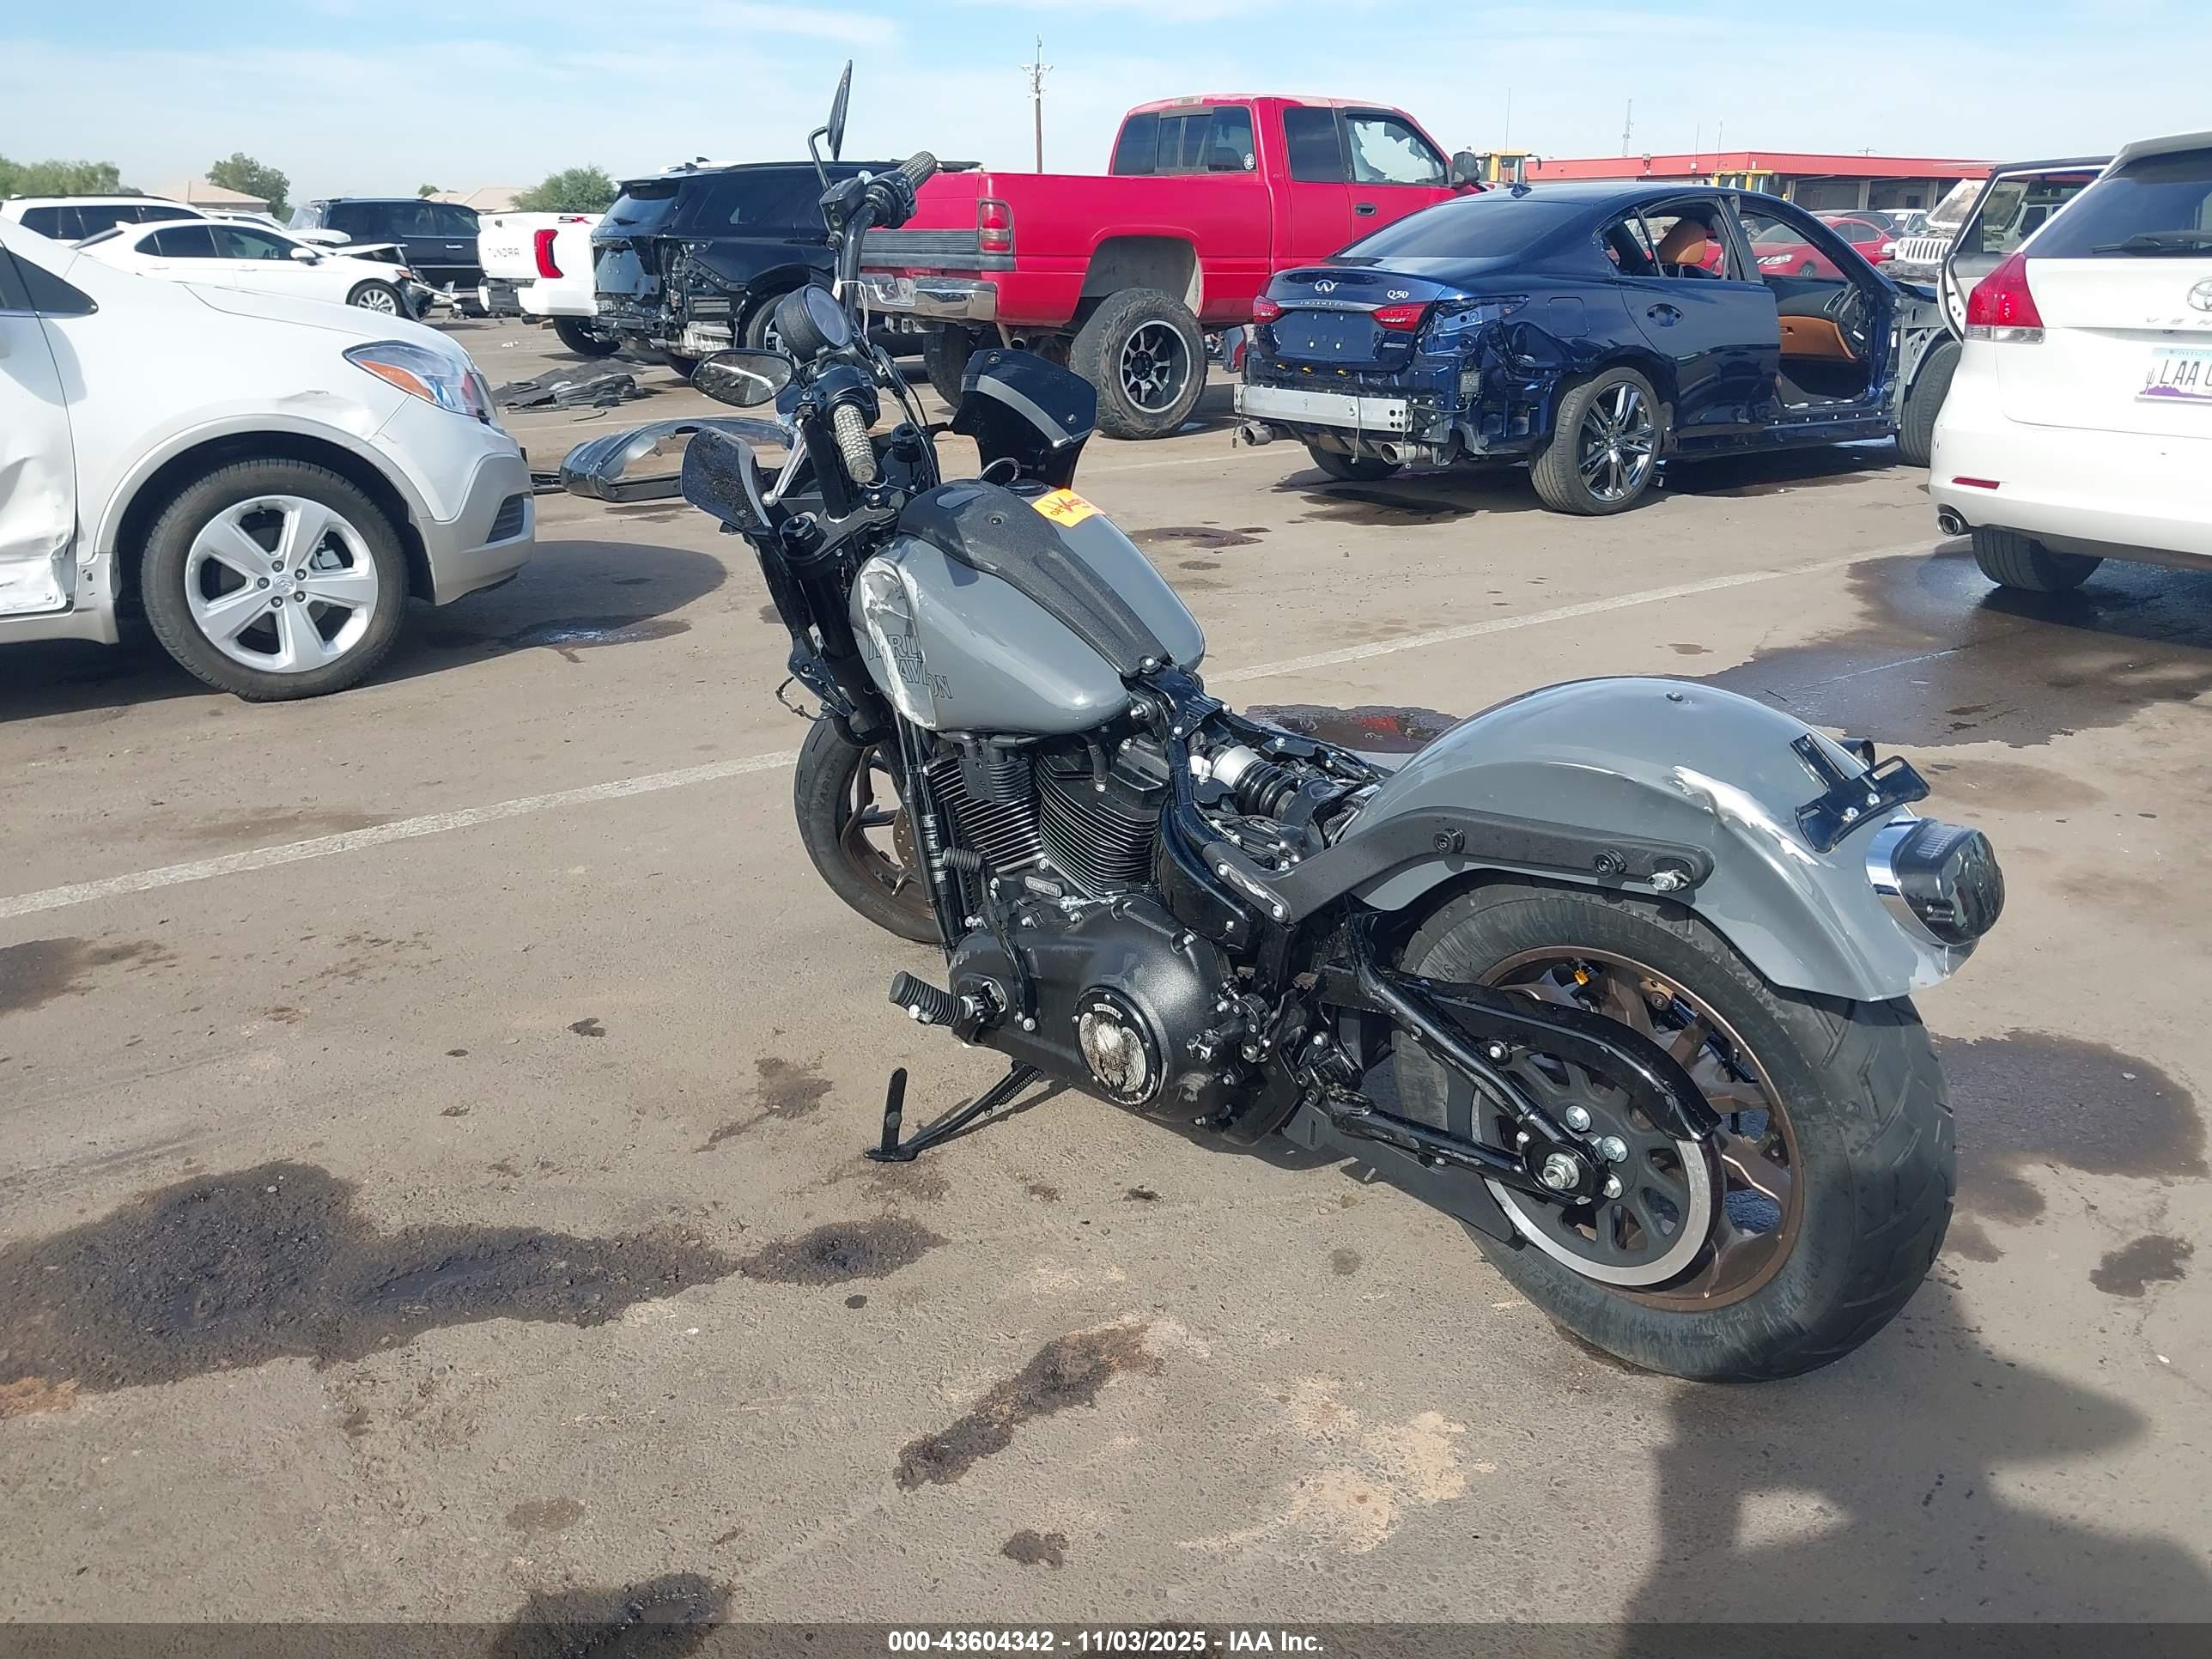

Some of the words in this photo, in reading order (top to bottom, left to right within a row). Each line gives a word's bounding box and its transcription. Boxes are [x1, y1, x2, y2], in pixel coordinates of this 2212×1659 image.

[487, 247, 520, 258] TUNDRA
[1387, 289, 1410, 301] Q50
[2160, 359, 2200, 386] LAA
